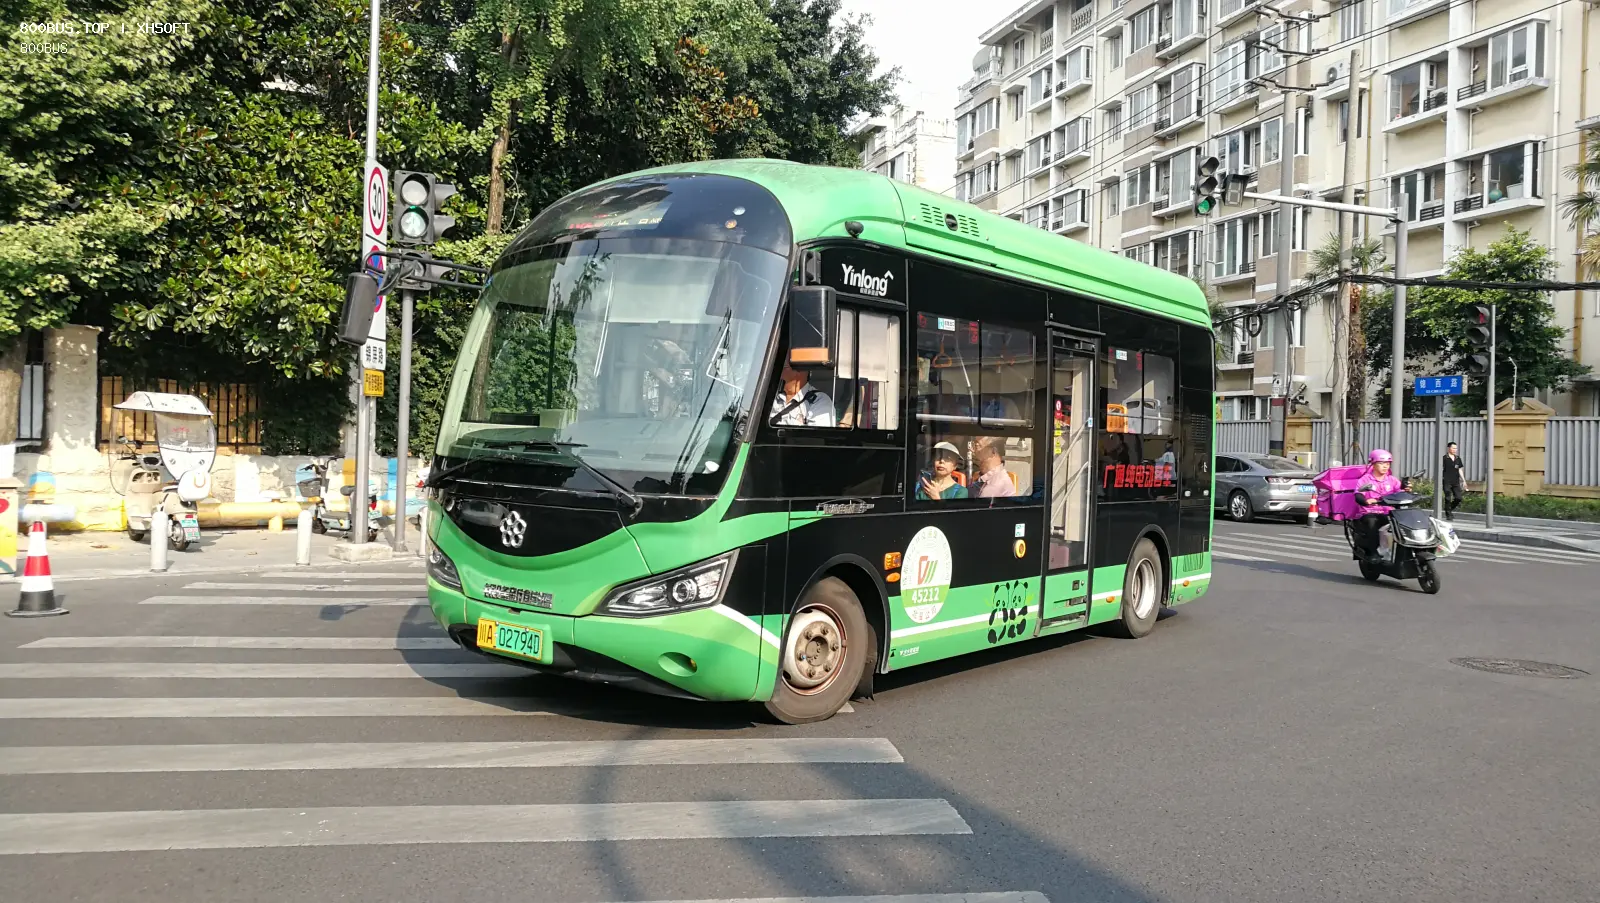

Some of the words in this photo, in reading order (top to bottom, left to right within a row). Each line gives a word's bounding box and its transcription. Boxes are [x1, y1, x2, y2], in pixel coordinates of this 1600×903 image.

[371, 182, 382, 220] 30
[841, 263, 888, 297] Yinlong
[1103, 464, 1172, 488] 广通纯电动客车
[911, 587, 940, 604] 45212
